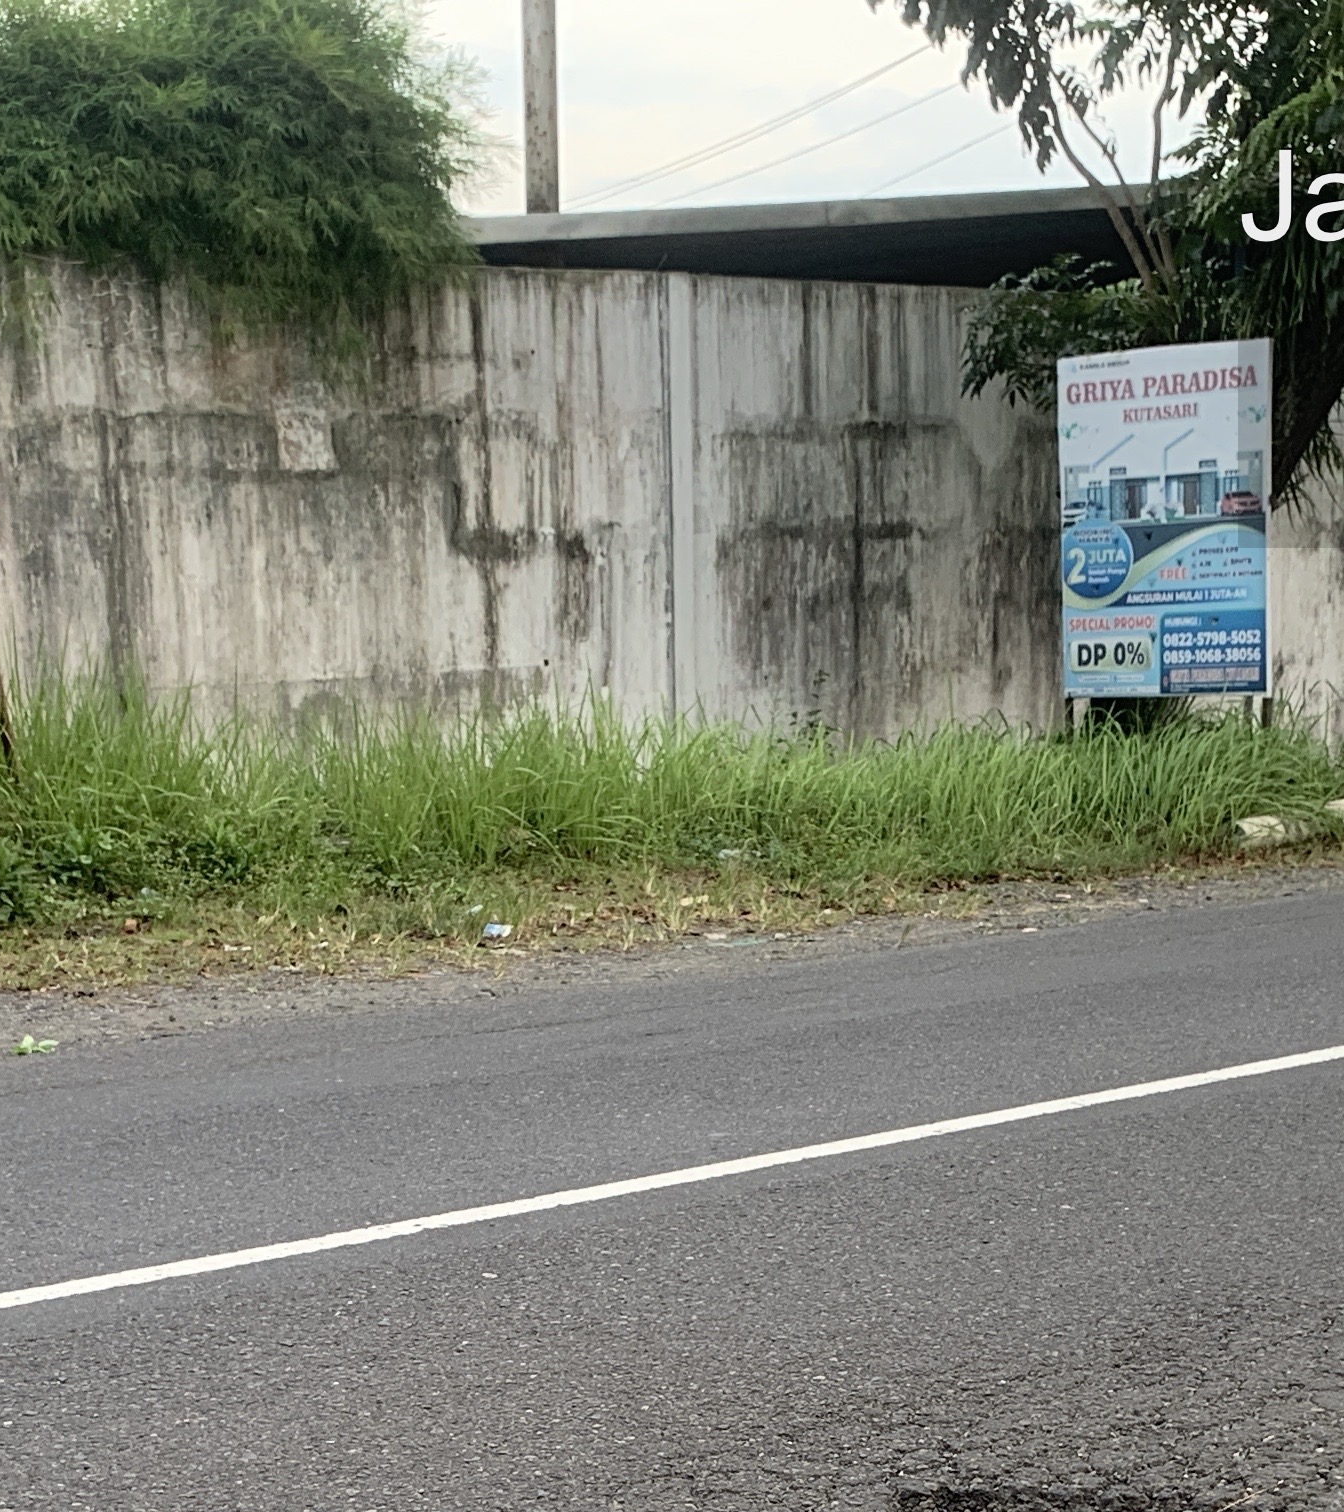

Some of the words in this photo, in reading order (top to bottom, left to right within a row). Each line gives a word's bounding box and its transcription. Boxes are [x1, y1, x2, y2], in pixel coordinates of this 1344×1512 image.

[1066, 379, 1136, 405] GRIYA
[1142, 365, 1258, 398] PARADISA
[1122, 402, 1199, 423] KUTASARI
[1067, 547, 1086, 584] 2
[1088, 549, 1126, 564] JUTA
[1160, 567, 1188, 580] FREE
[1070, 618, 1110, 631] SPECIAL
[1113, 616, 1155, 629] PROMO!
[1077, 642, 1107, 667] DP
[1114, 641, 1145, 666] 0%
